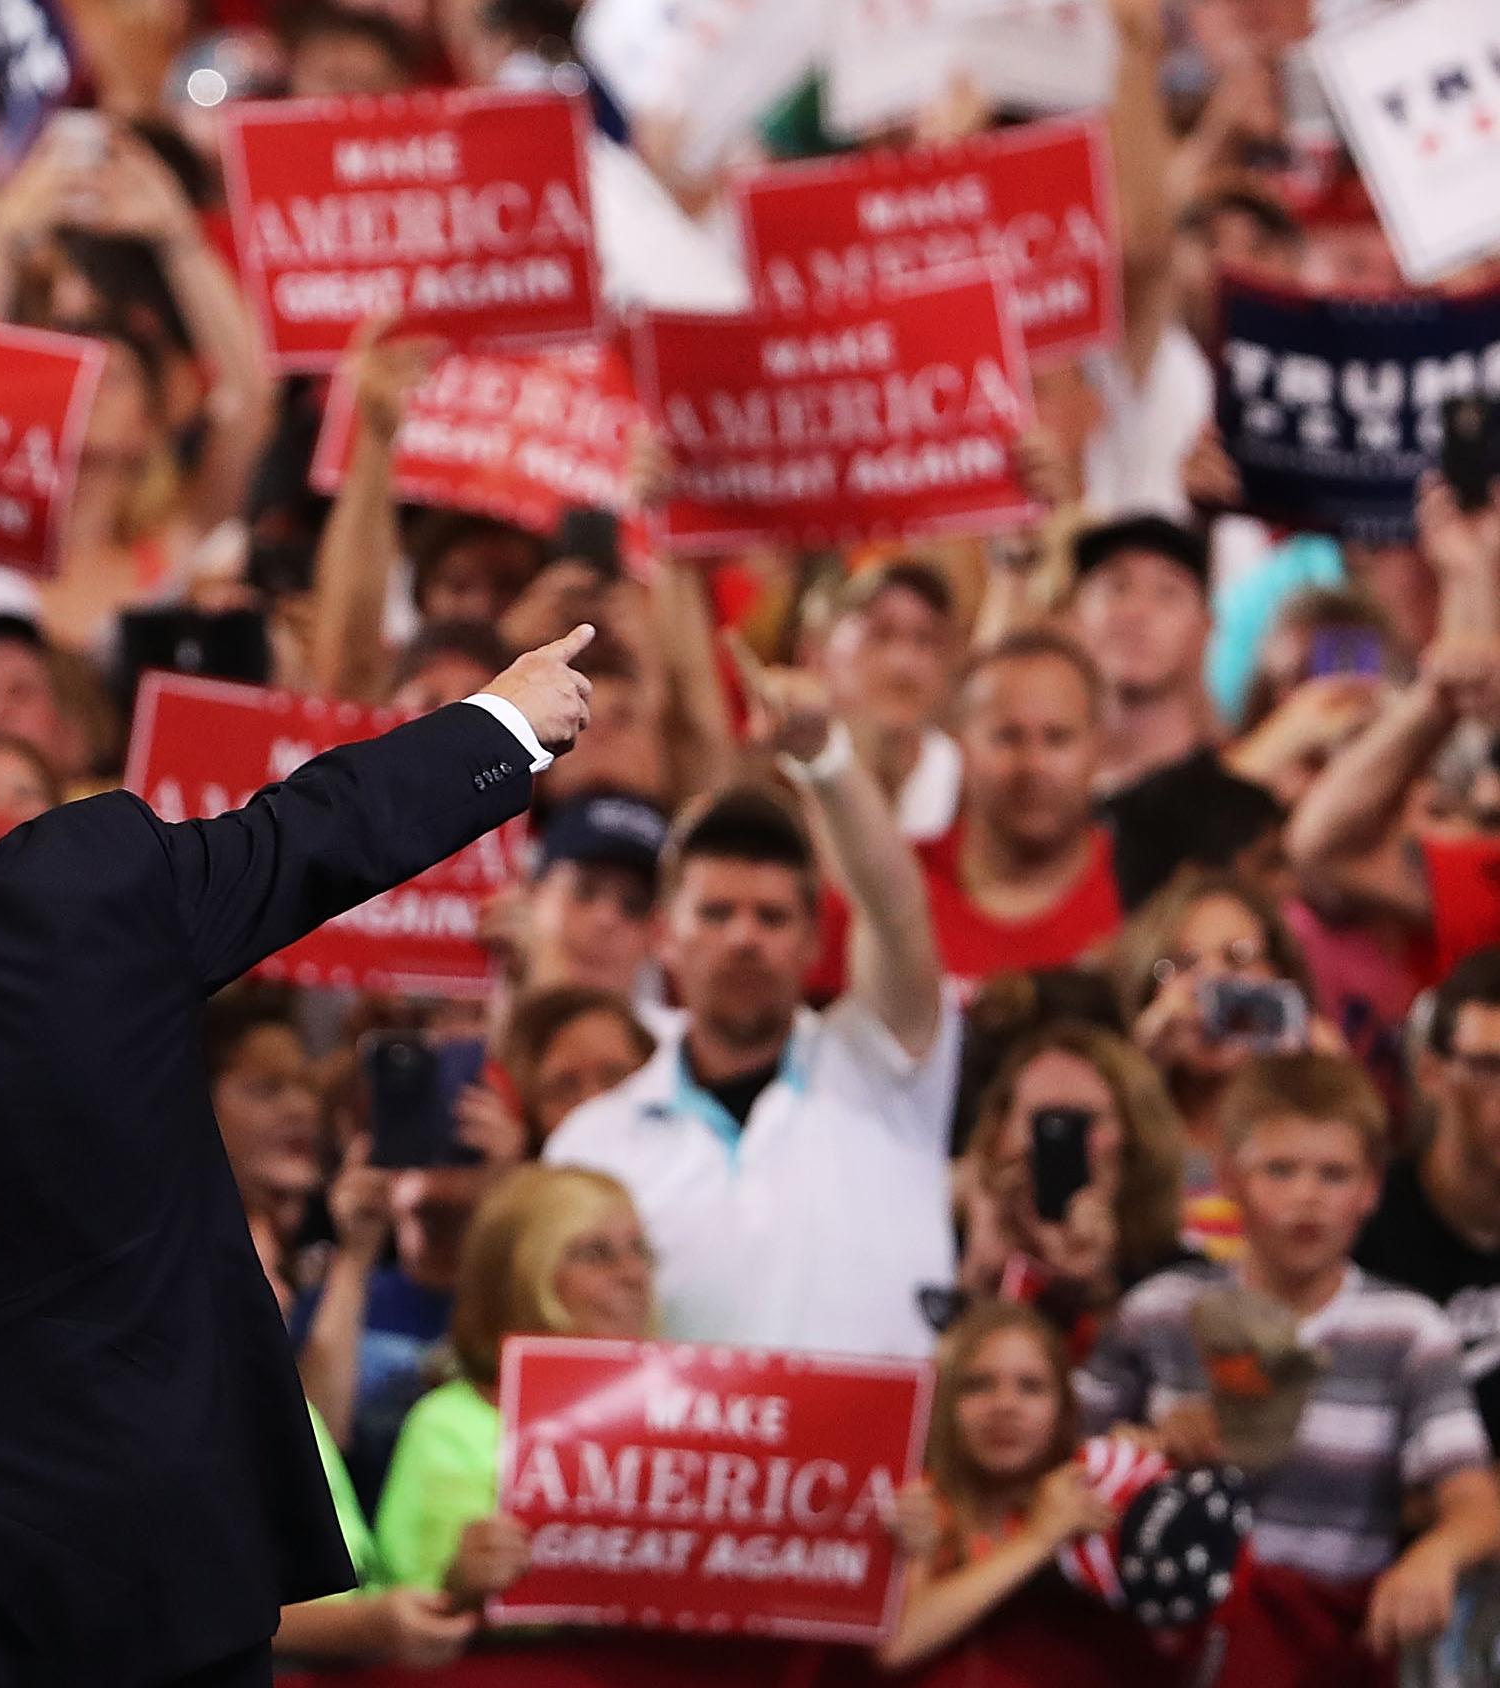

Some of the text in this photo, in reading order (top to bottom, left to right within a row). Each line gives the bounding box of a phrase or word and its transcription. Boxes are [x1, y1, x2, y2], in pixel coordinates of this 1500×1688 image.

[248, 178, 590, 262] AMERICA
[644, 1388, 792, 1444] MAKE
[506, 1438, 900, 1532] AMERICA
[530, 1522, 870, 1586] GREAT AGAIN
